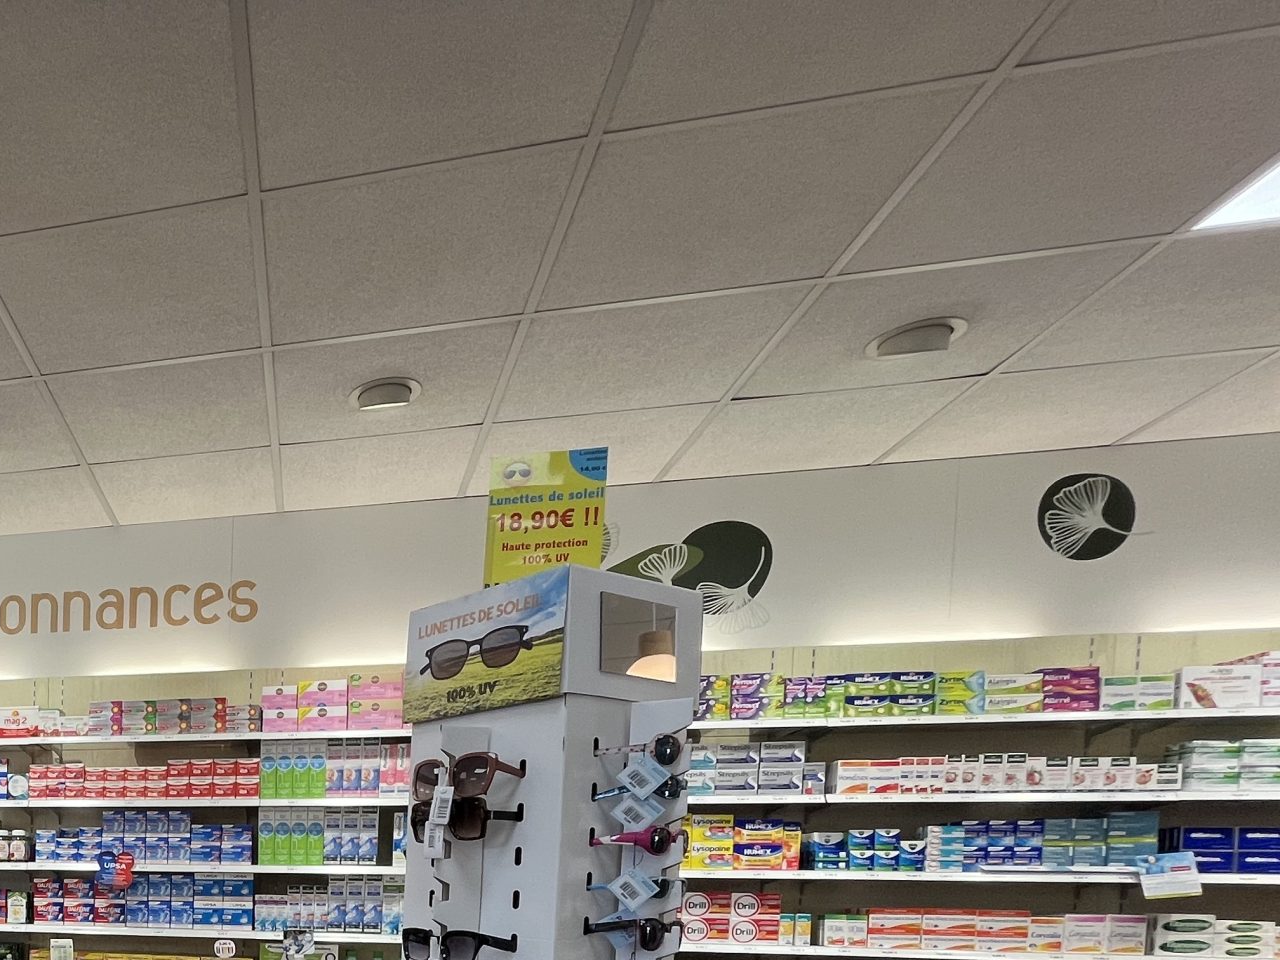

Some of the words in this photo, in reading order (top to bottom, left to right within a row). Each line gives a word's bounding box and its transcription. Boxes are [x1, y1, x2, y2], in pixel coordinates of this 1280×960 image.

[489, 493, 544, 506] Lunettes
[548, 490, 564, 502] de
[568, 486, 606, 501] soleil
[496, 507, 575, 534] 18,90€
[501, 541, 532, 552] Haute
[534, 537, 589, 552] protection
[523, 553, 552, 565] 100%
[555, 552, 570, 563] UV
[418, 610, 476, 641] LUNETTES
[478, 605, 495, 624] DE
[496, 592, 542, 618] SOLEIL
[3, 718, 19, 727] mag
[719, 743, 752, 751] Strepsils
[763, 743, 796, 751] Strepsils
[717, 770, 749, 778] Strepsils
[761, 770, 794, 778] Strepsils
[692, 817, 731, 826] Lysopaine
[691, 844, 731, 854] Lysopaine
[743, 848, 772, 856] HUMEX
[104, 862, 127, 870] UPSA
[688, 900, 707, 910] Drill
[737, 901, 756, 911] Drill
[686, 926, 705, 935] Drill
[735, 927, 754, 937] Drill
